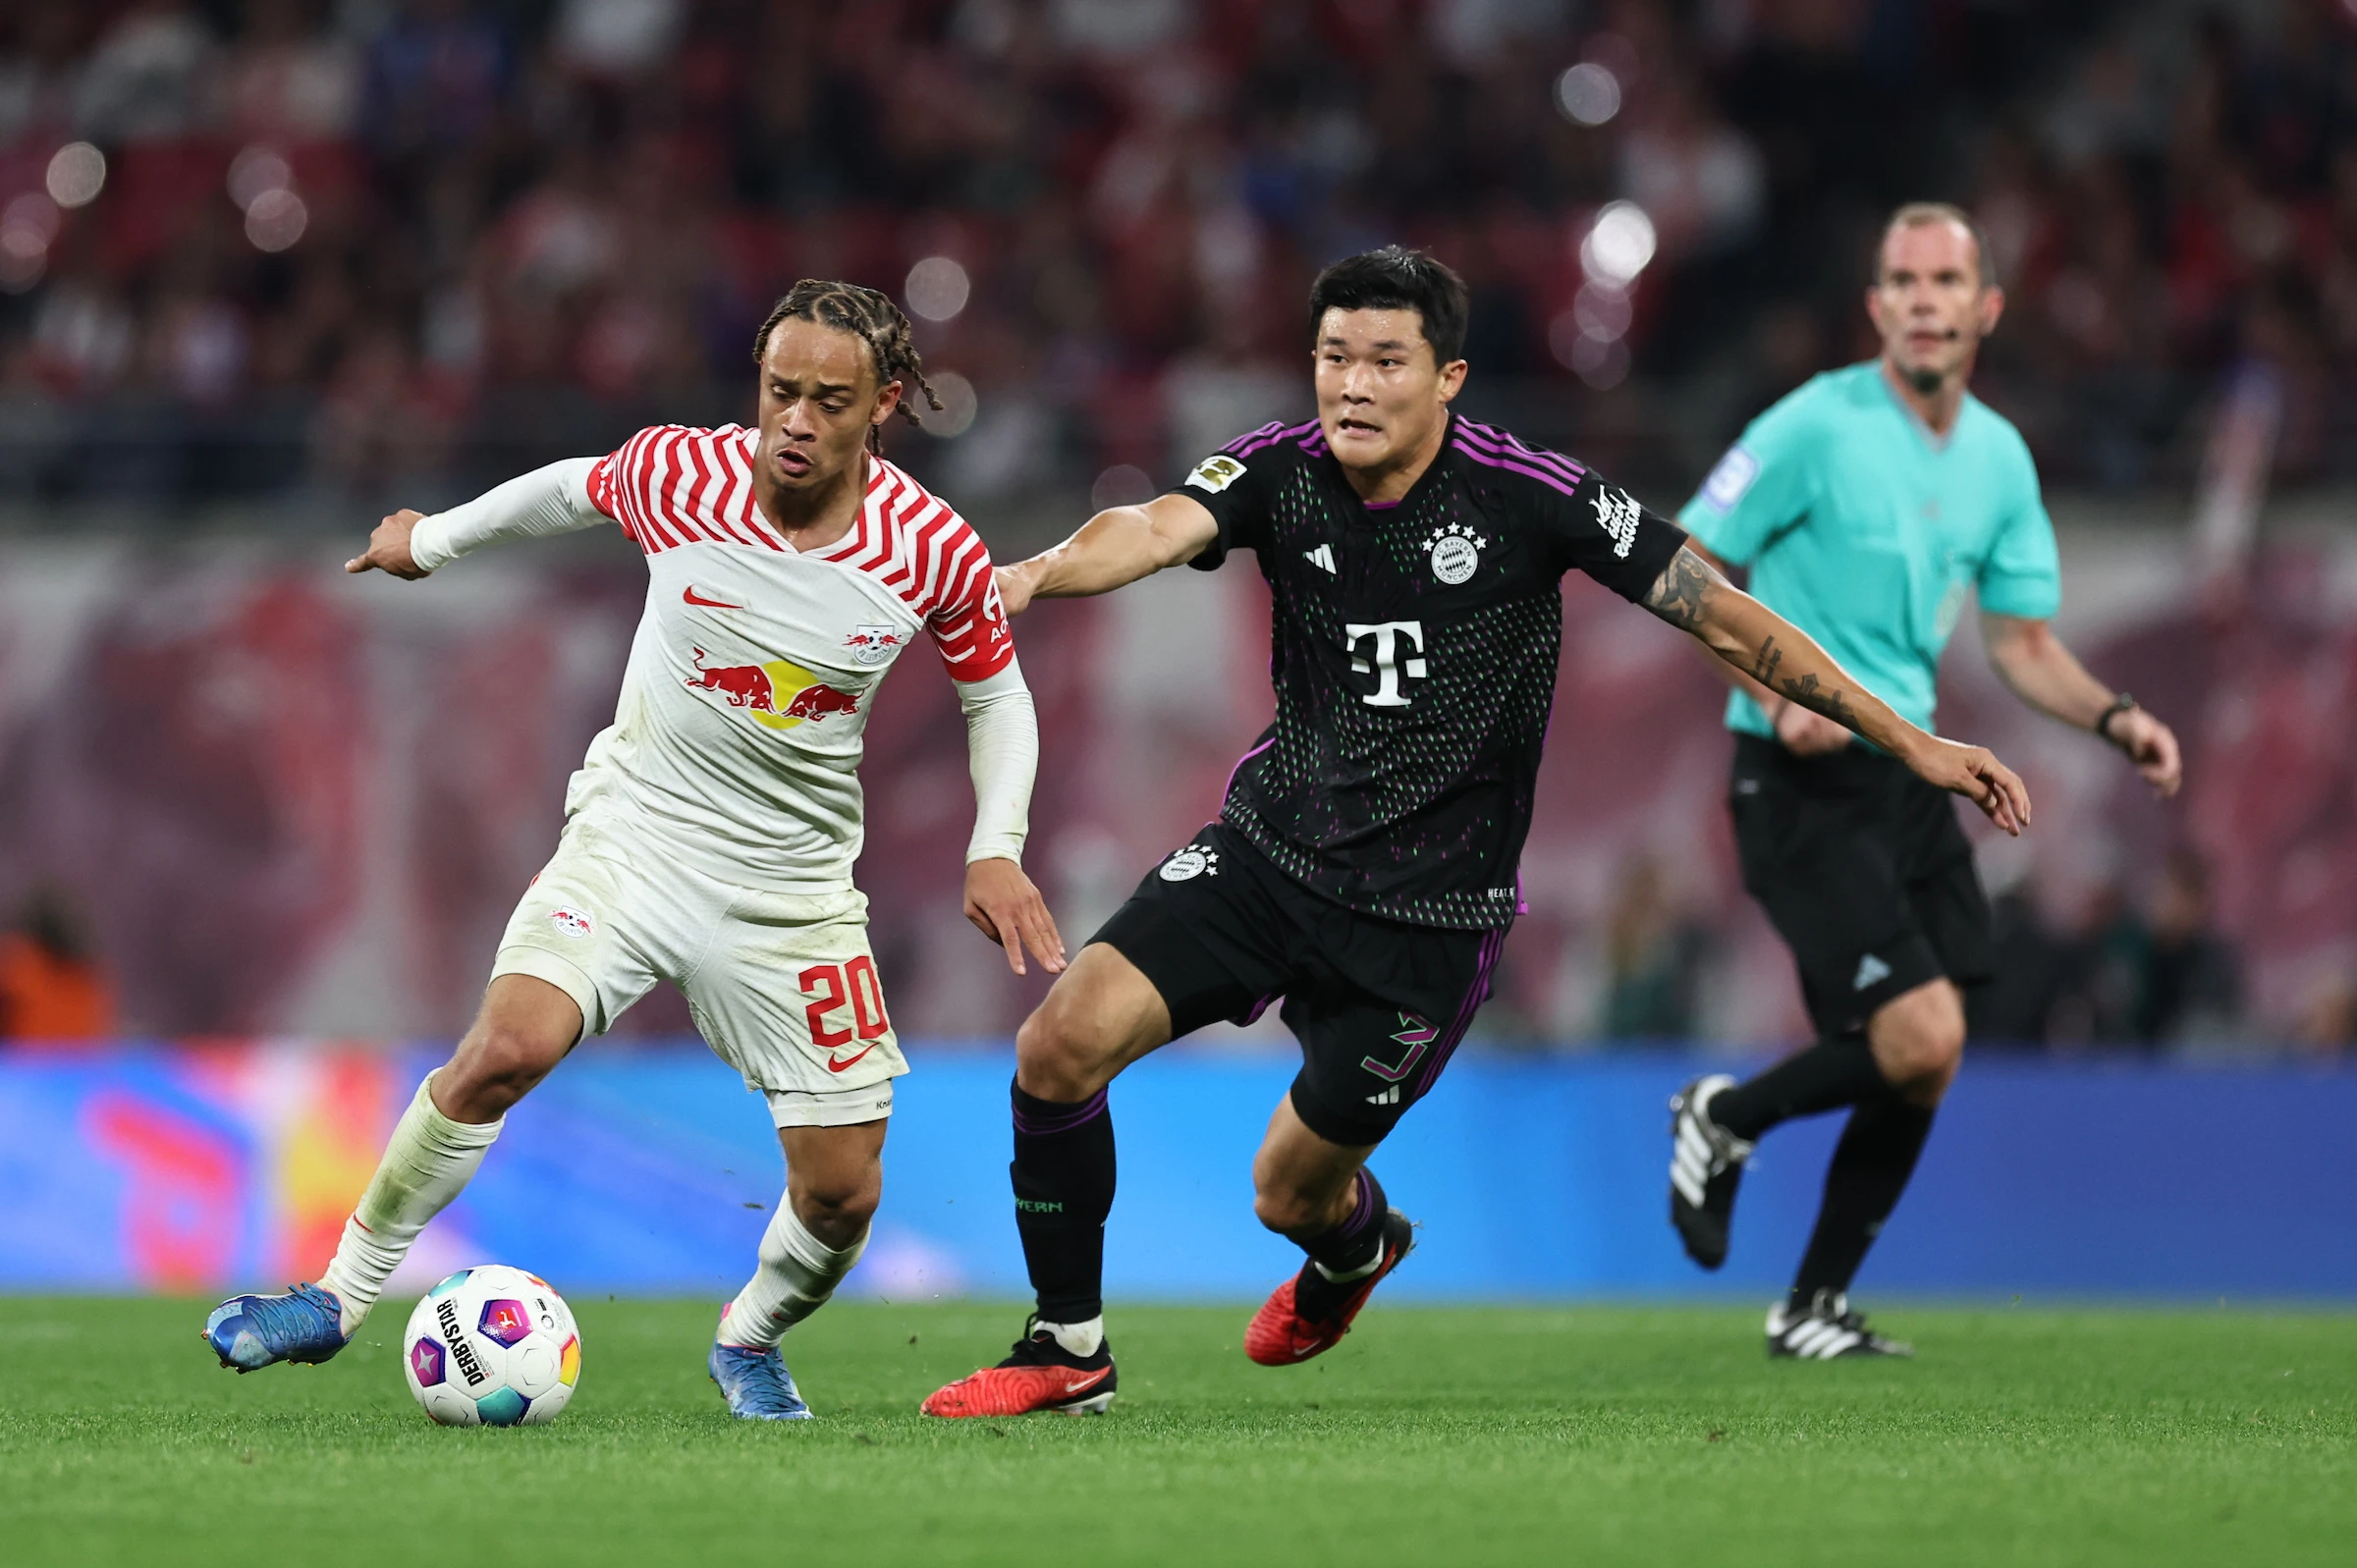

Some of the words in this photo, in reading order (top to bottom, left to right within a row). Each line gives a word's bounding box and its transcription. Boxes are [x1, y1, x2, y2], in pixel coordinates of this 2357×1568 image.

[1444, 541, 1472, 558] BAYERN
[1345, 621, 1427, 706] T
[798, 955, 889, 1048] 20
[437, 1299, 485, 1387] DERBYSTAR
